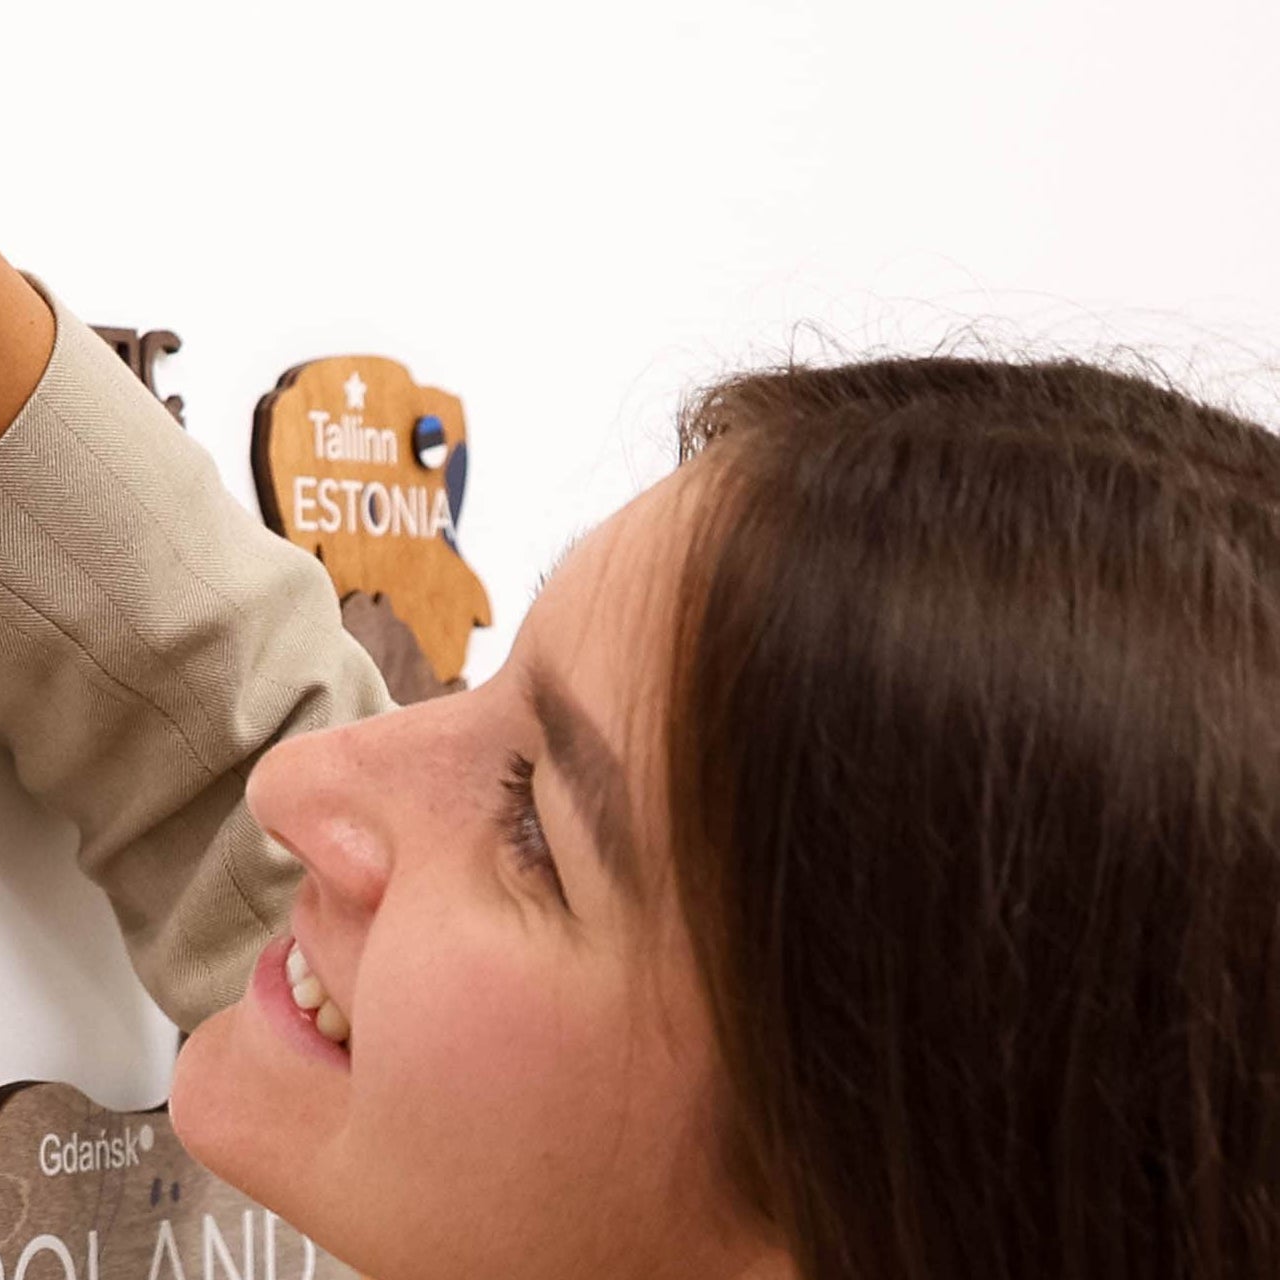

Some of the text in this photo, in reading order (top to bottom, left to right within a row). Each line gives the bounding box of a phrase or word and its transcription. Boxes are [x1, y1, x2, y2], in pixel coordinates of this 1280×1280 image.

[308, 410, 398, 465] Tallinn
[293, 475, 457, 539] ESTONIA
[40, 1128, 139, 1177] Gdańsk
